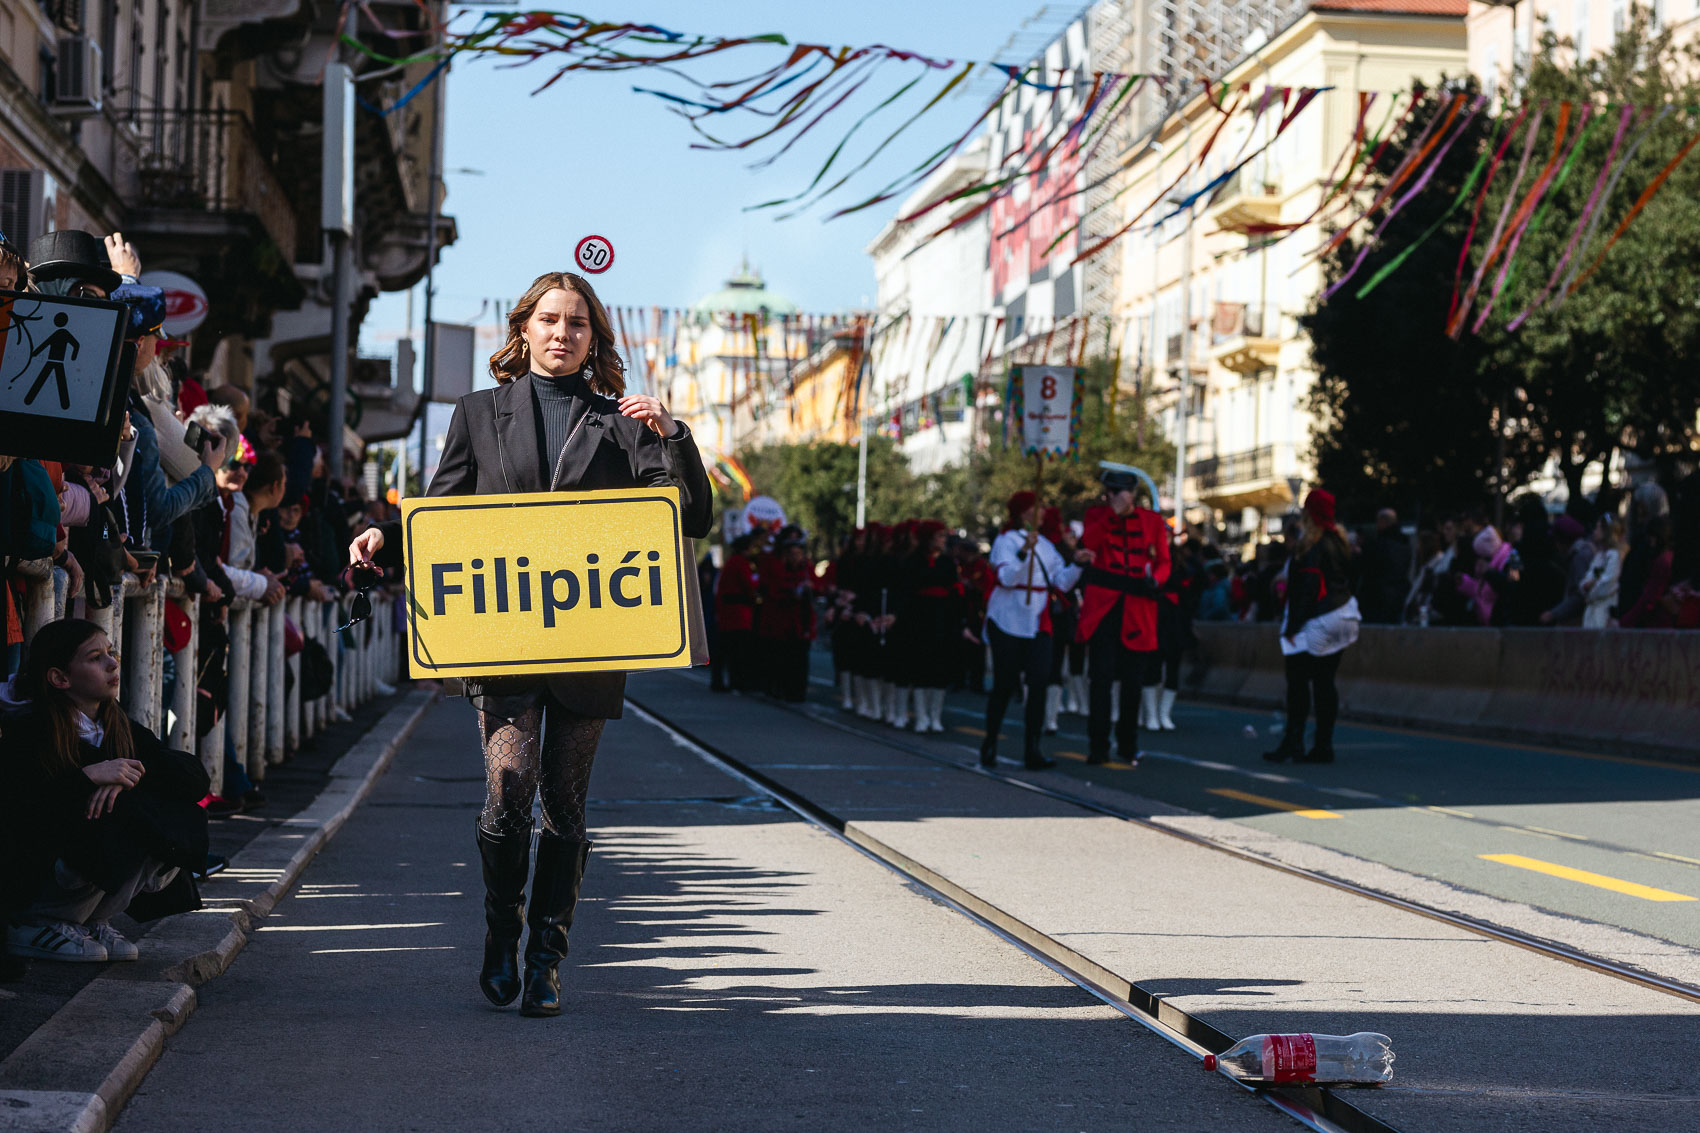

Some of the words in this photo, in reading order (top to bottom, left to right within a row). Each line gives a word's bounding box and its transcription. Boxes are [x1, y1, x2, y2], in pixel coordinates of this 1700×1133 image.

[583, 242, 607, 266] 50
[1041, 375, 1057, 400] 8
[431, 550, 663, 628] Filipići
